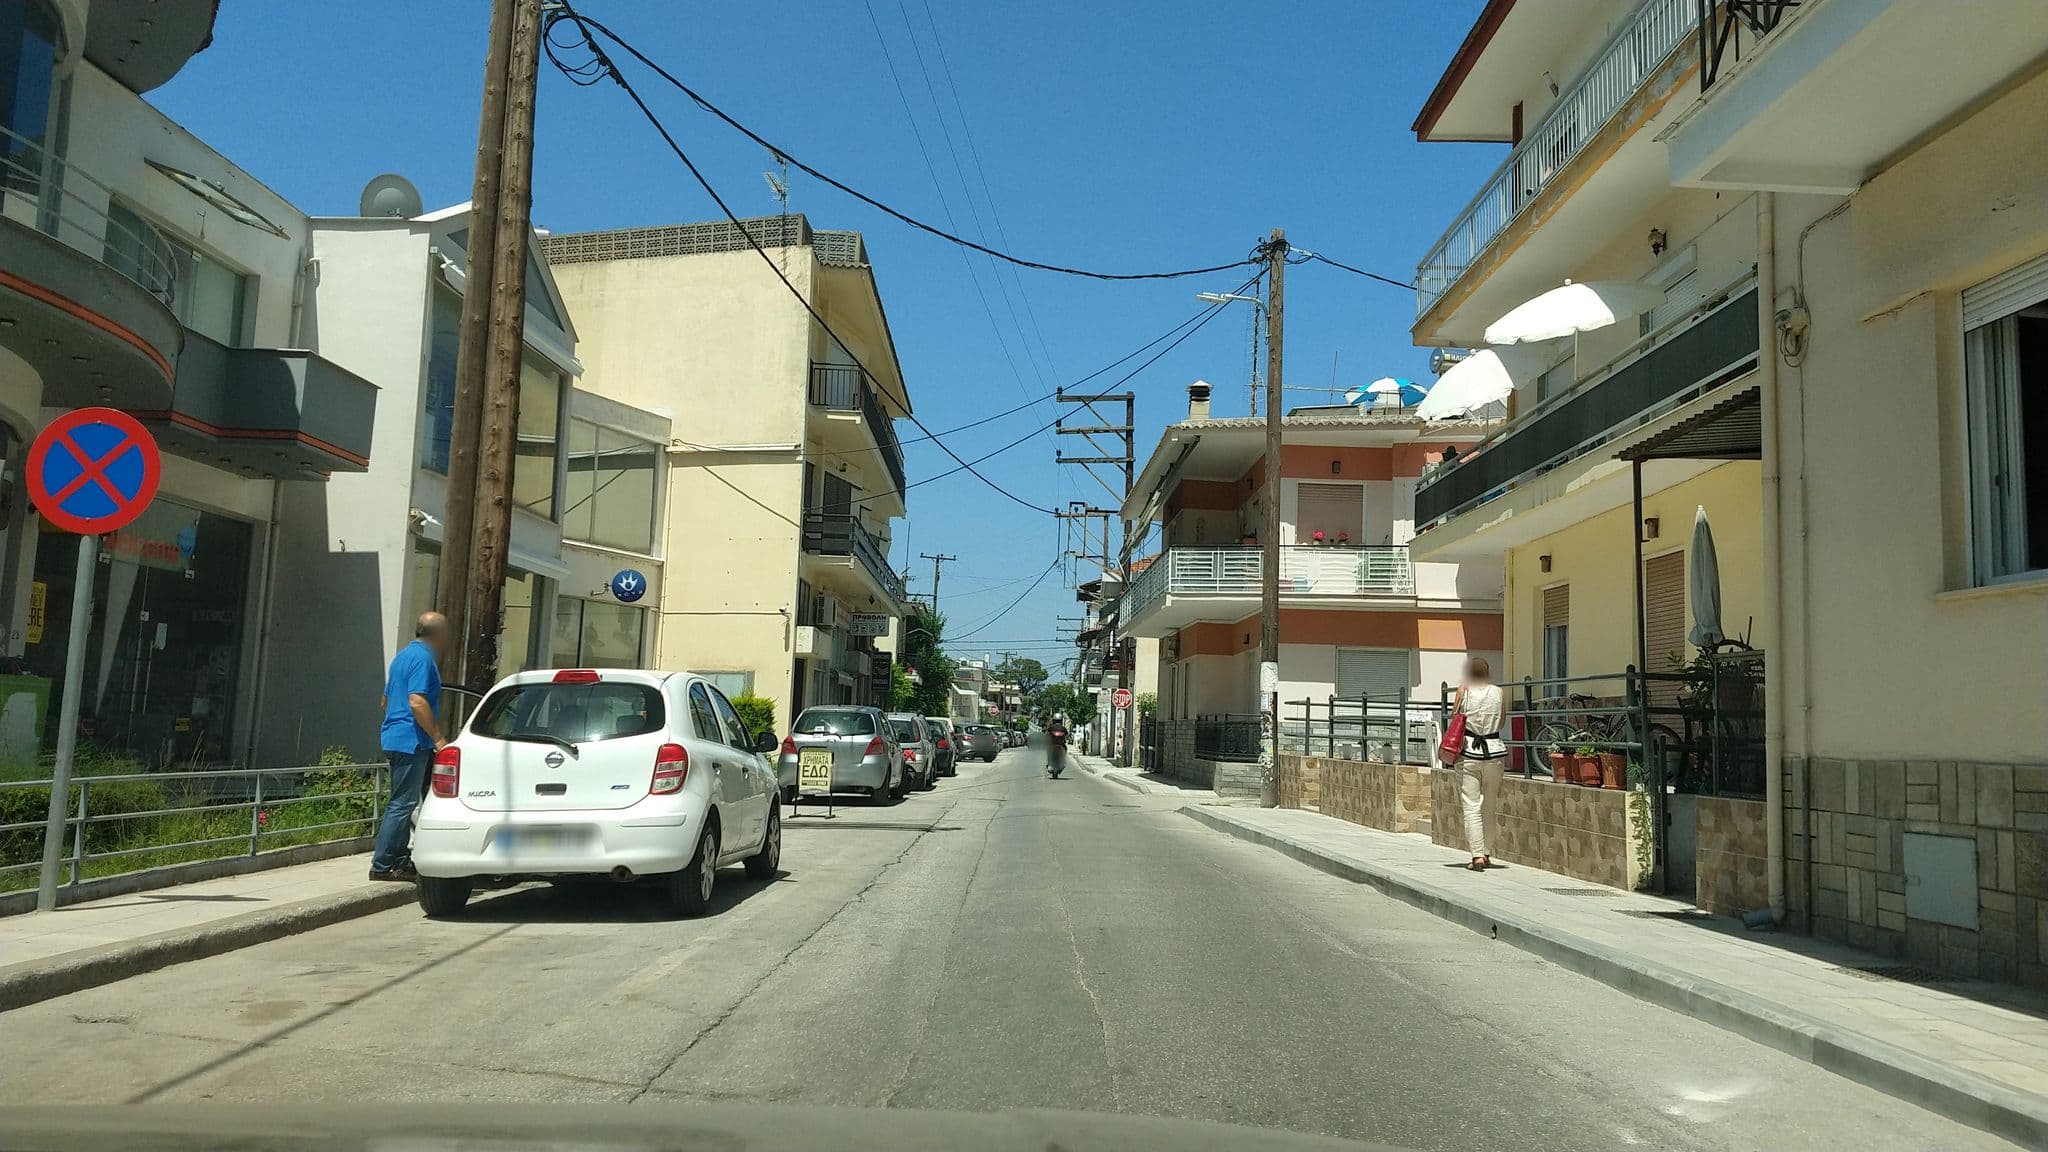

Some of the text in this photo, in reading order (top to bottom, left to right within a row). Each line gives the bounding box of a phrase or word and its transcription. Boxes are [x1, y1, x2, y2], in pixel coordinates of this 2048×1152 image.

[1114, 694, 1131, 705] STOP
[803, 755, 829, 765] ΧΡΗΜΑΤΑ
[802, 765, 828, 778] ΕΔΩ
[467, 790, 496, 798] MICRA
